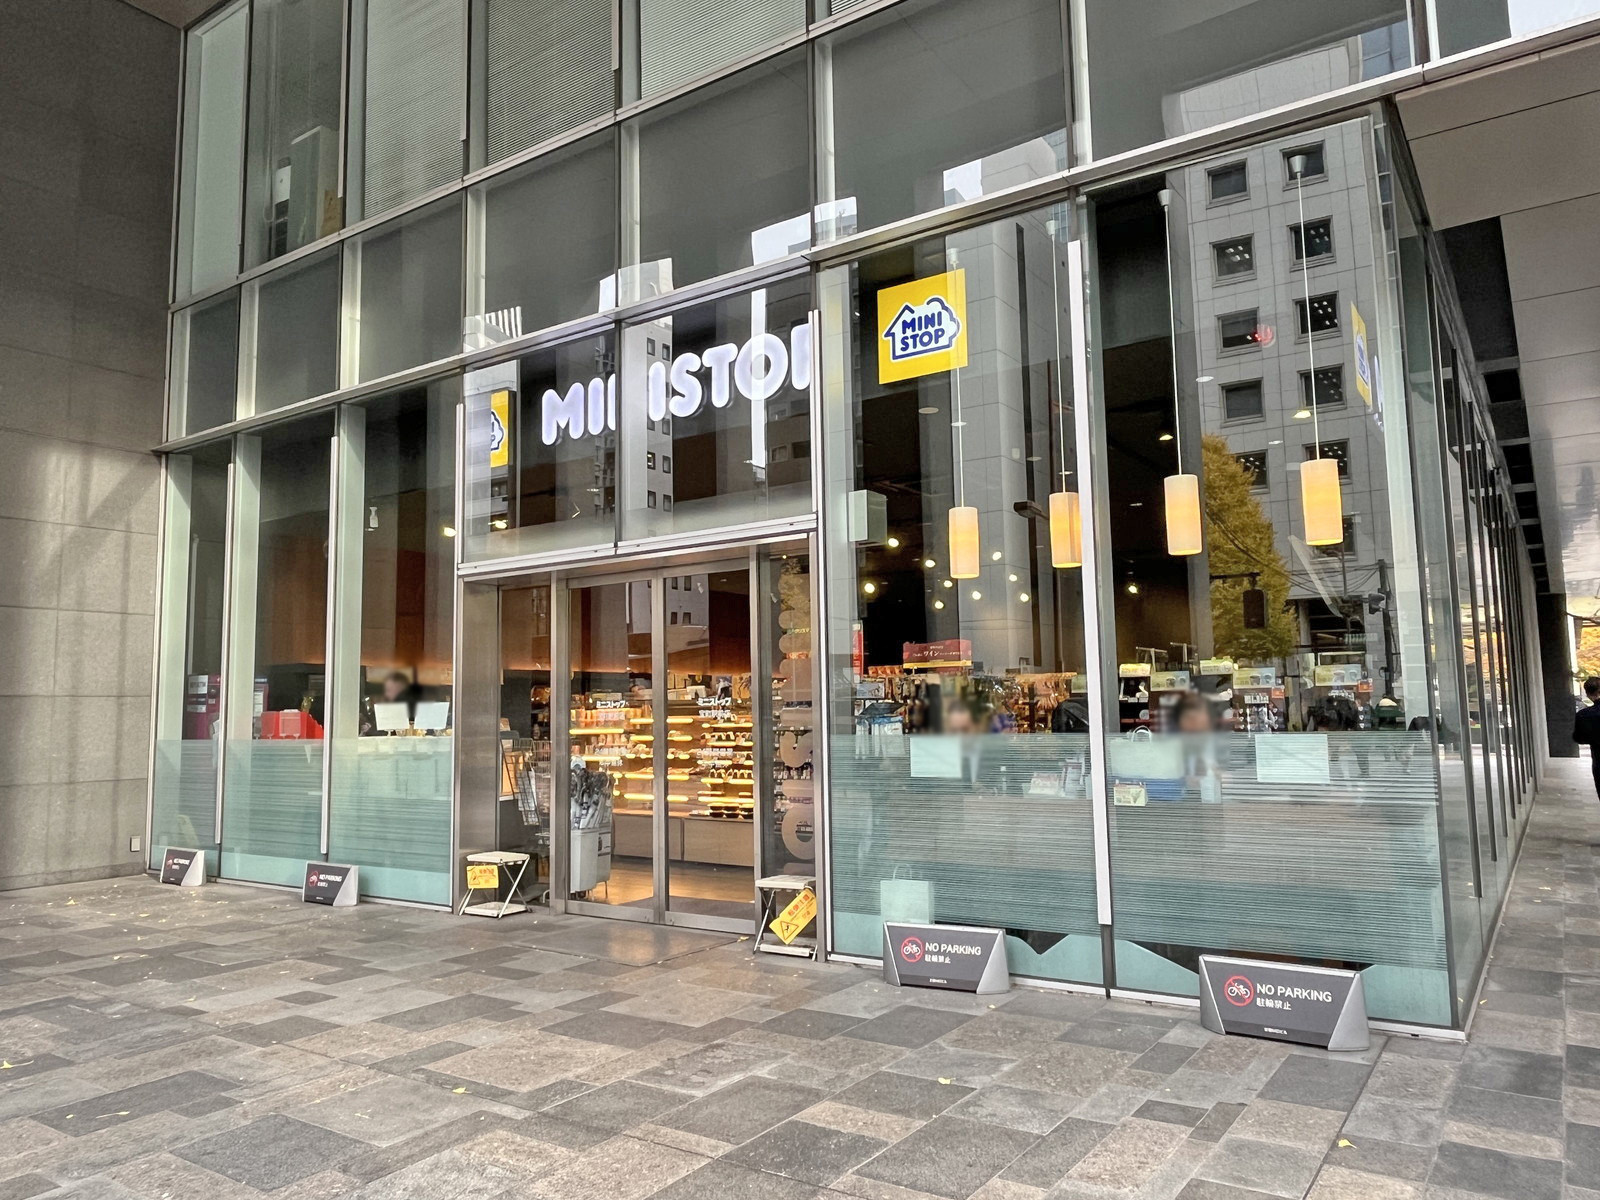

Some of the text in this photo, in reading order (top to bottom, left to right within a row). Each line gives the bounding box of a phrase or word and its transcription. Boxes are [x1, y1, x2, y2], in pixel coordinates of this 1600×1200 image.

[901, 311, 942, 335] MINI
[900, 328, 946, 352] STOP
[925, 942, 982, 956] NO PARKING
[1256, 982, 1333, 1003] NO PARKING
[1256, 997, 1292, 1011] 駐輪禁止
